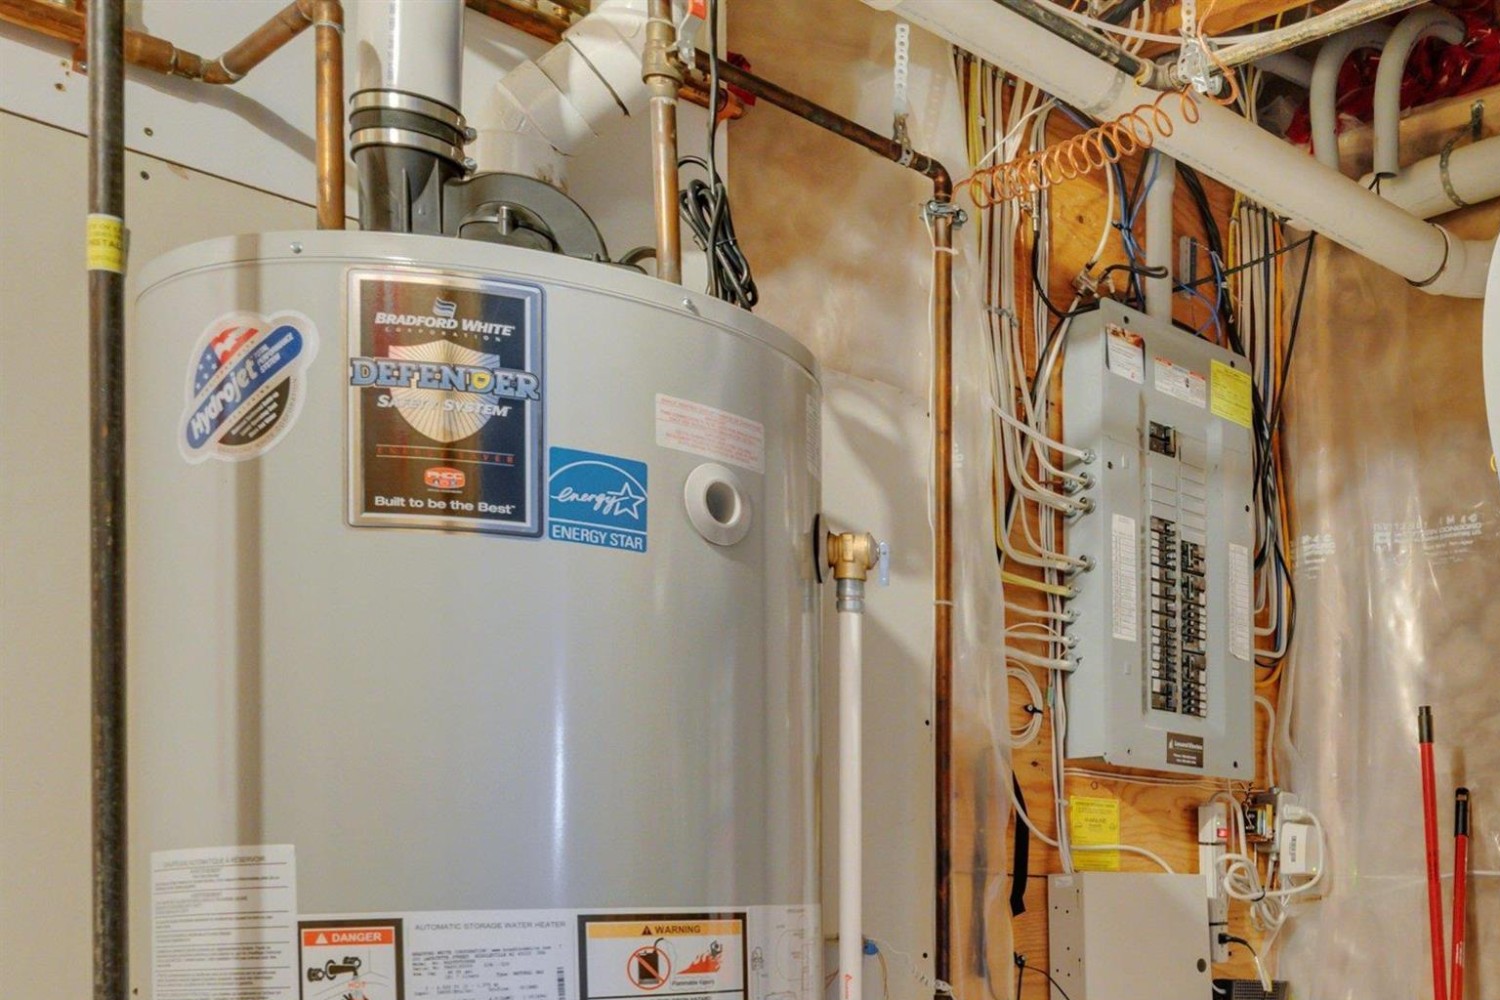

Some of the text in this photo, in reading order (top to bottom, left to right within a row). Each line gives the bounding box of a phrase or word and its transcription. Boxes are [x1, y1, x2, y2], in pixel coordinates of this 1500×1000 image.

[375, 312, 513, 336] BRADFORD WHITE
[384, 326, 502, 343] CORPORATION
[350, 357, 541, 400] DEFENDER
[191, 358, 258, 441] Hydrojet
[377, 394, 508, 418] SAFETY SYSTEM
[374, 496, 512, 515] Built to be the Best
[552, 525, 644, 551] ENERGY STAR
[414, 920, 567, 931] AUTOMATIC STORAGE WATER HEATER
[653, 924, 702, 935] WARNING
[331, 931, 382, 944] DANGER
